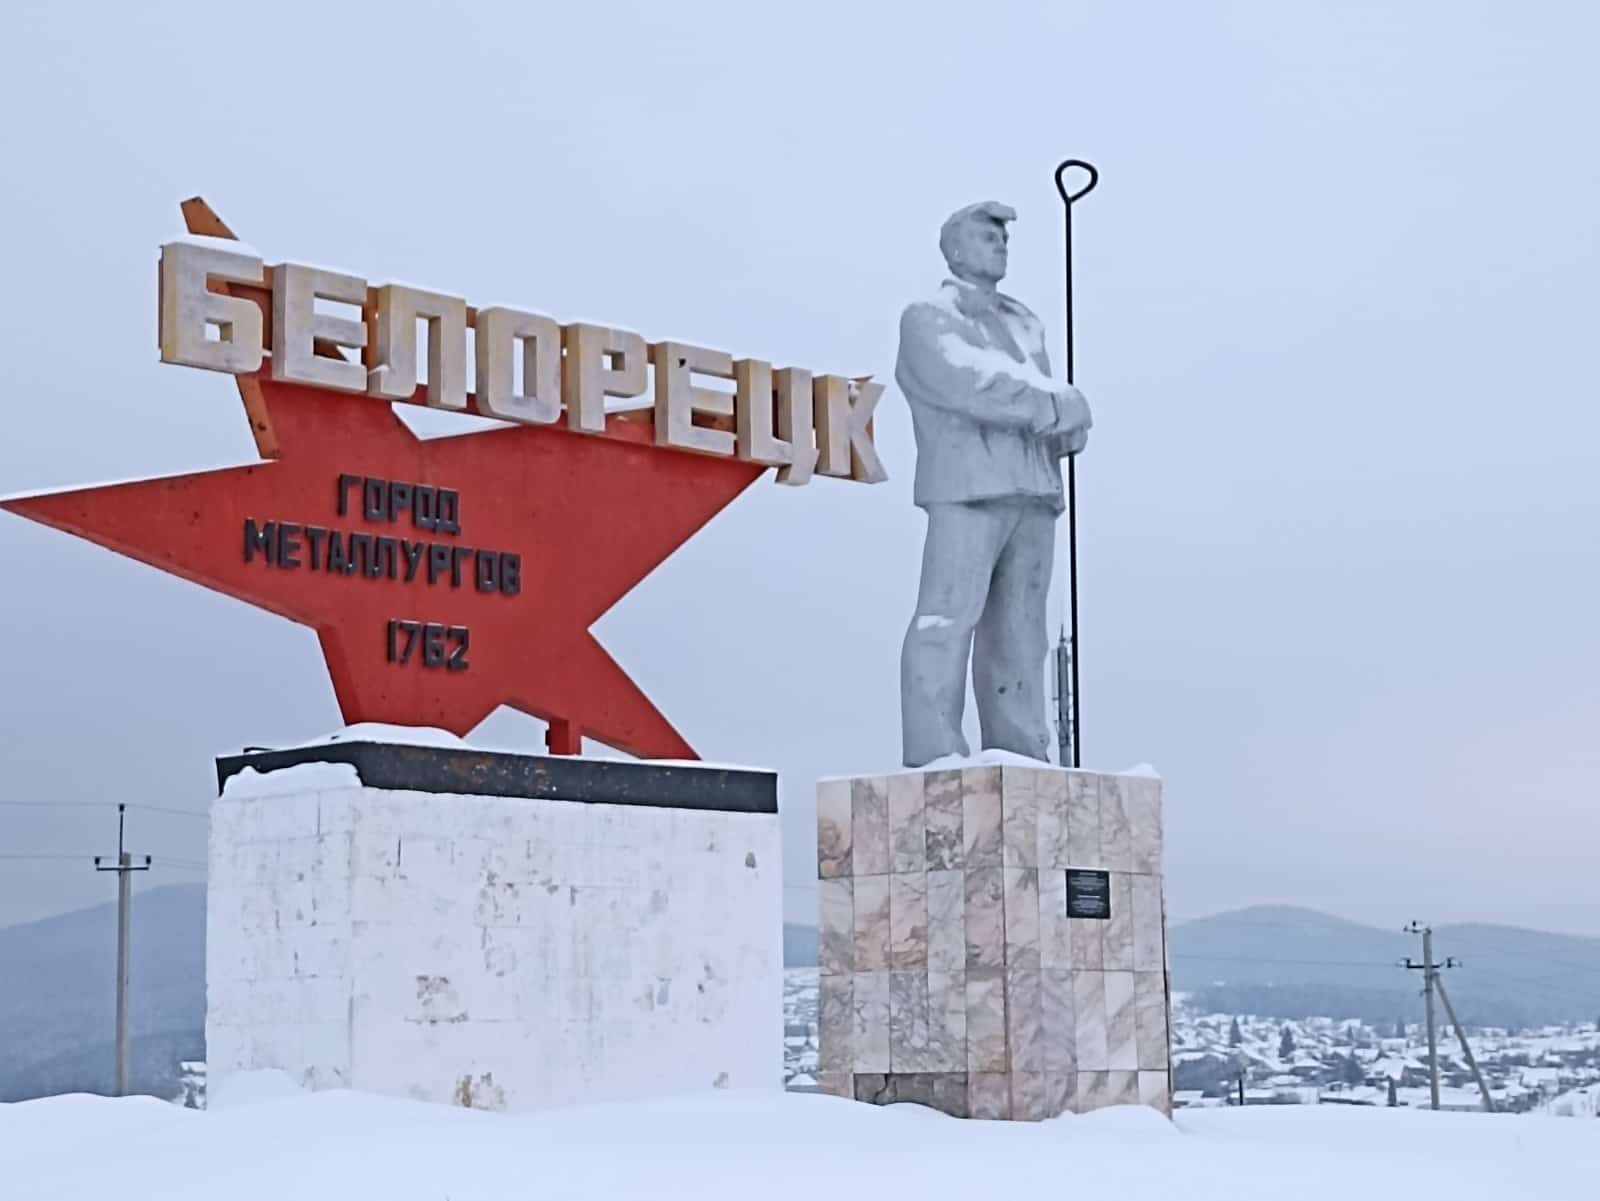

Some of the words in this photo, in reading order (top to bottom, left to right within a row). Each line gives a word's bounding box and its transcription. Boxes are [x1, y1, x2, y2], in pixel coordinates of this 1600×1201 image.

[158, 242, 889, 486] БЕЛОРЕЦК
[338, 473, 461, 536] ГОРОД
[244, 517, 521, 596] МЕТАЛЛУРГОВ
[387, 619, 470, 671] 1762
